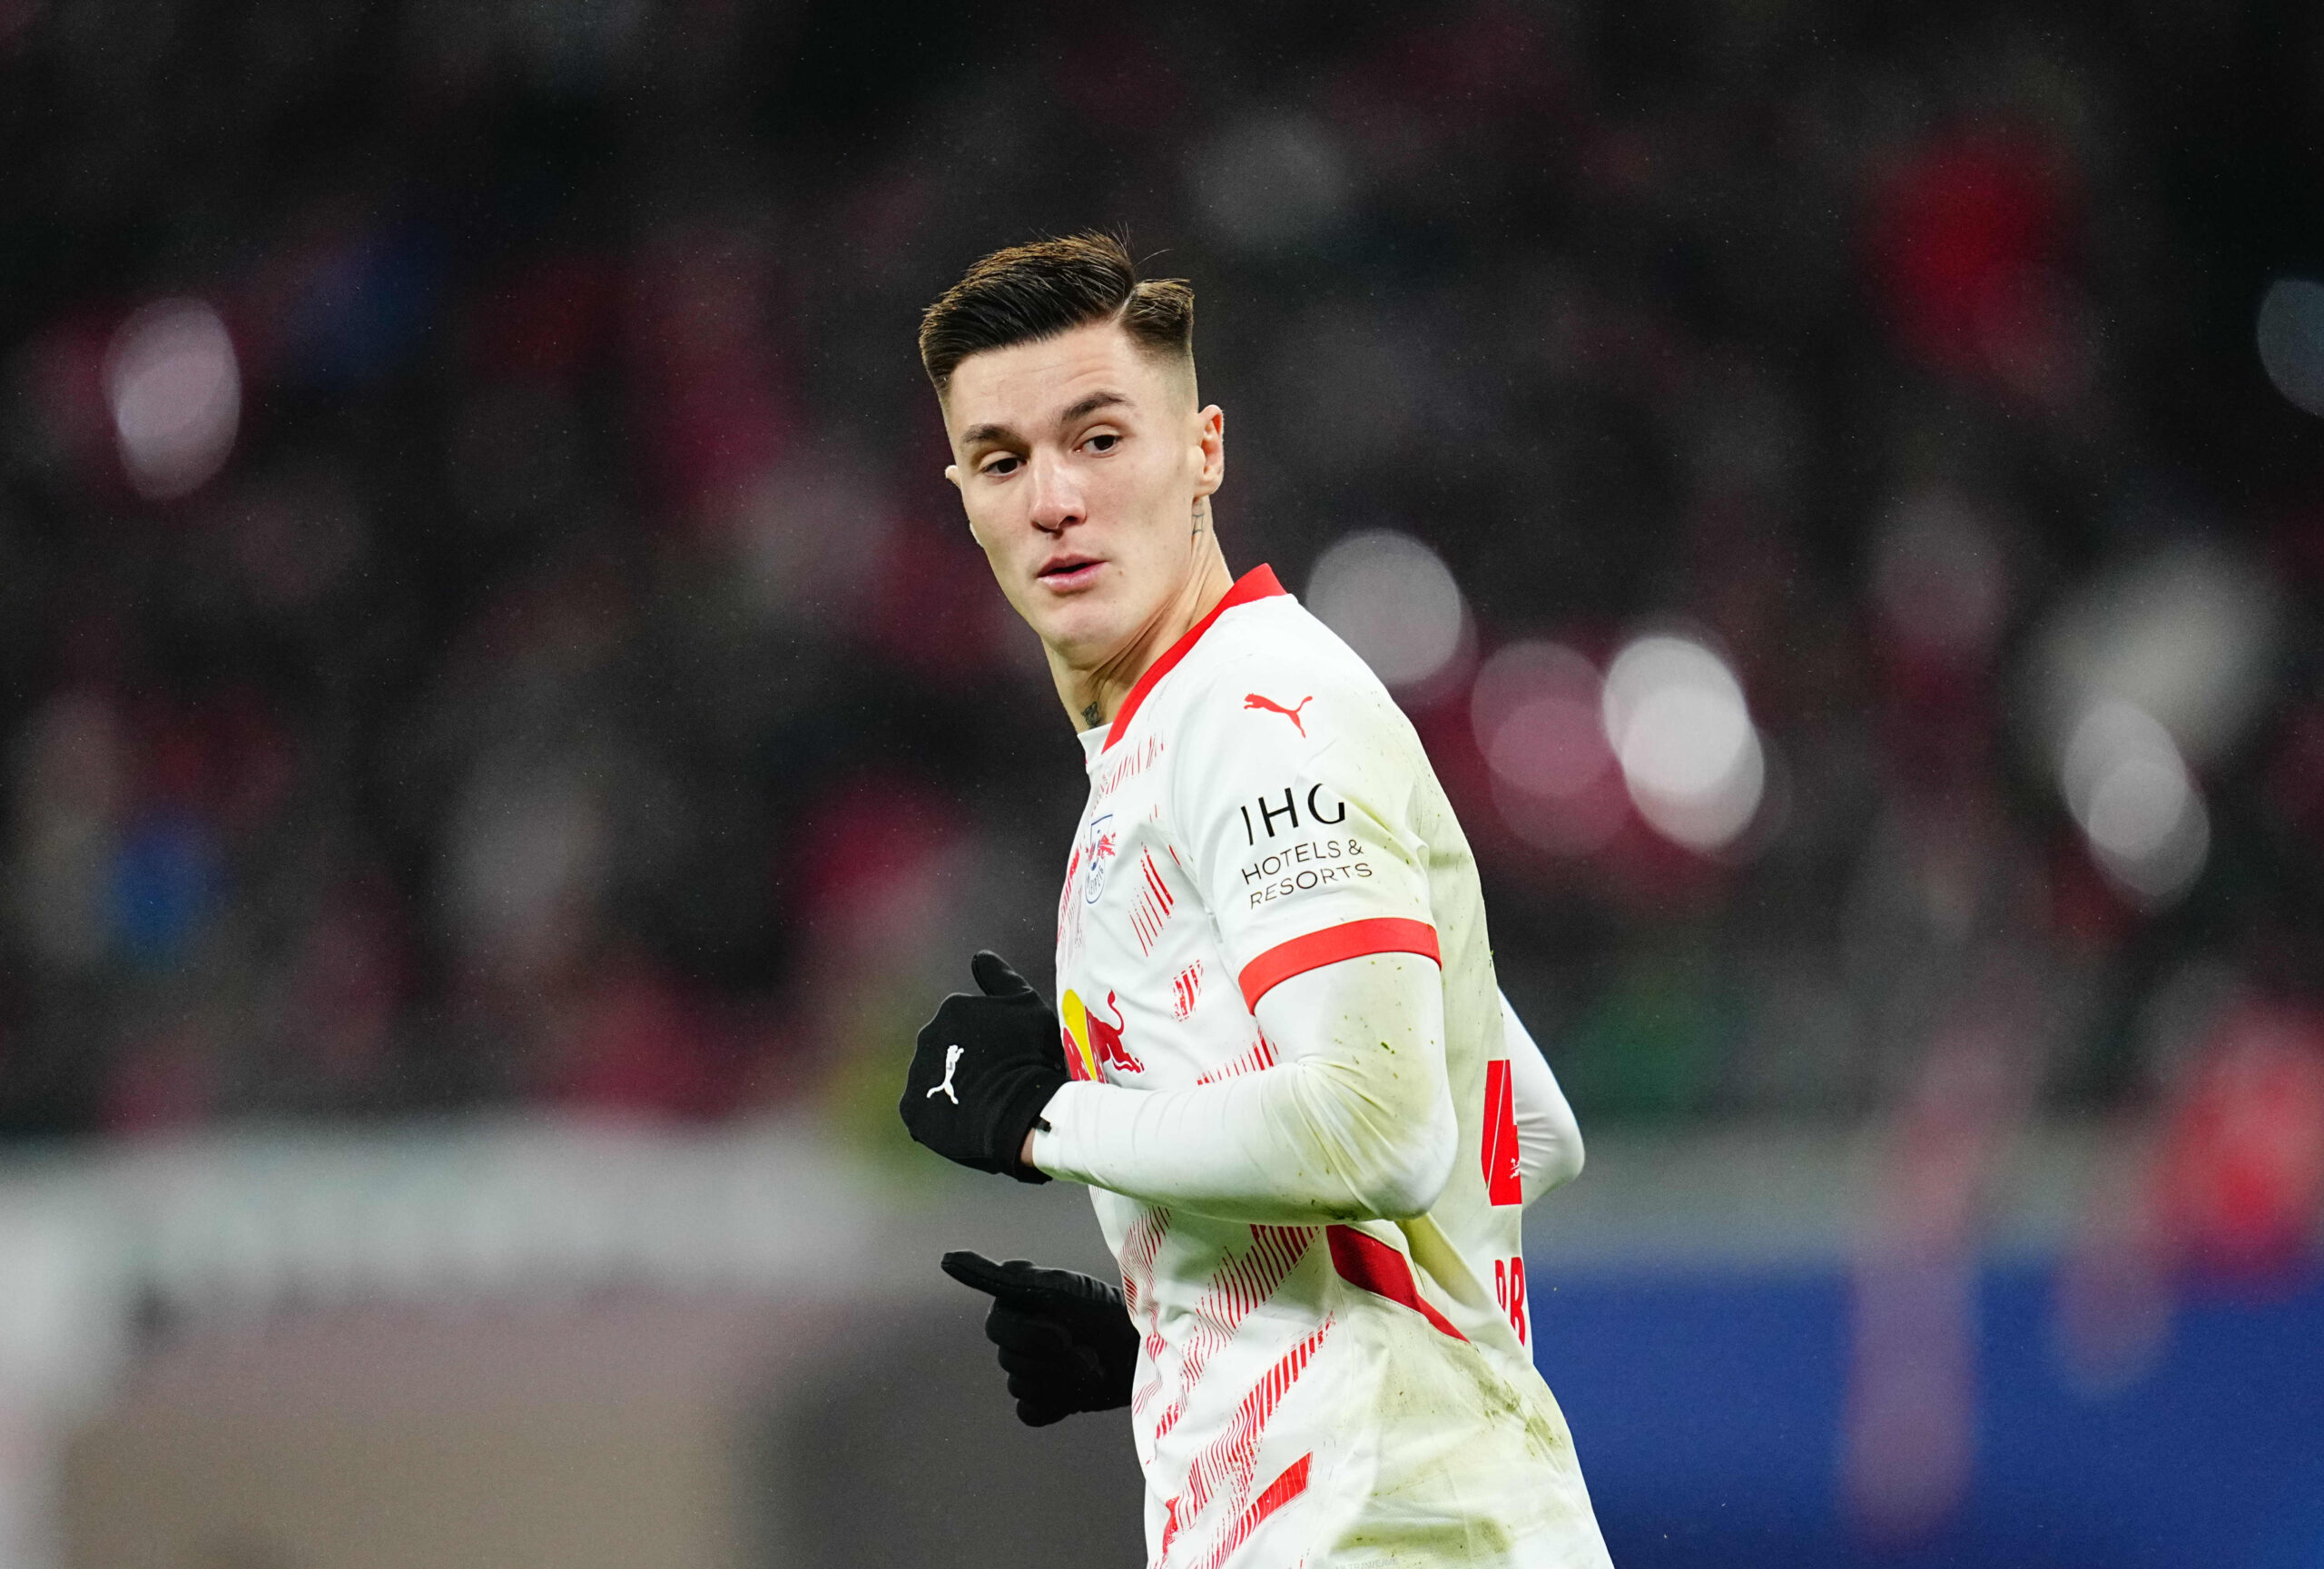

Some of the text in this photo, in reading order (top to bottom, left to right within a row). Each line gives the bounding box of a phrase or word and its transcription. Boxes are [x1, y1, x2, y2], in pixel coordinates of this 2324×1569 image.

[1240, 783, 1345, 845] IHG
[1241, 839, 1364, 885] HOTELS &
[1250, 863, 1374, 910] RESORTS
